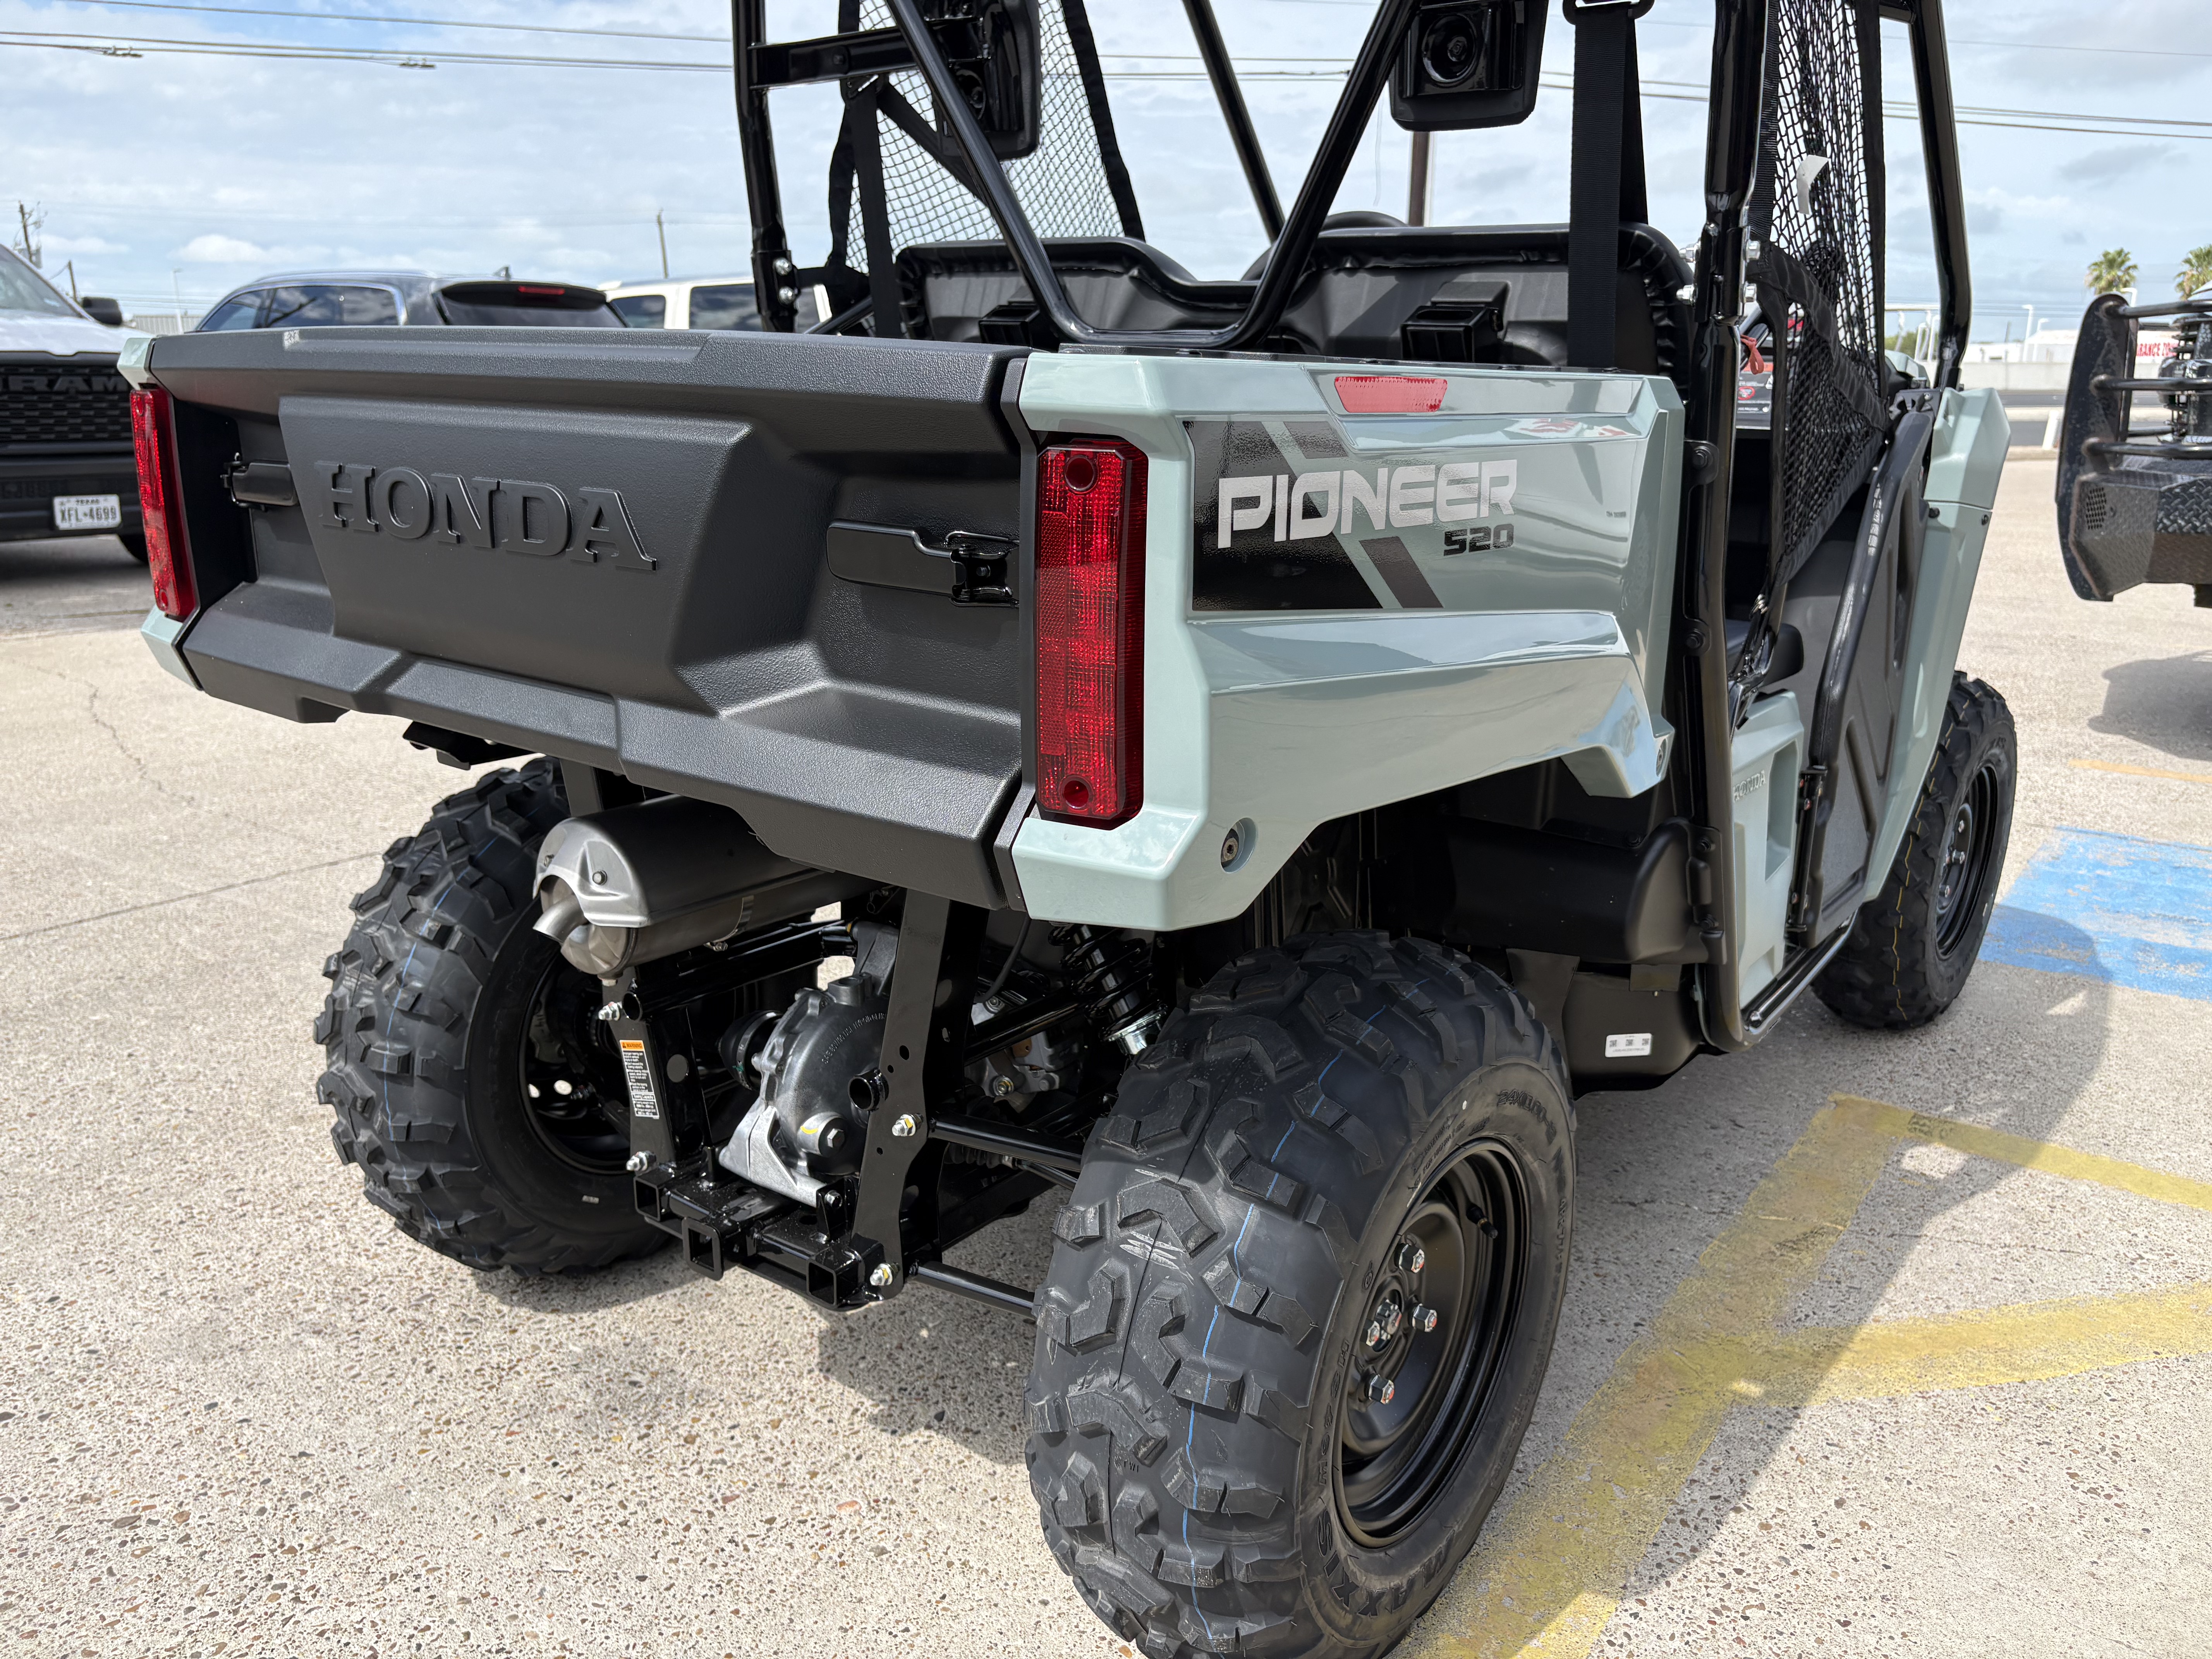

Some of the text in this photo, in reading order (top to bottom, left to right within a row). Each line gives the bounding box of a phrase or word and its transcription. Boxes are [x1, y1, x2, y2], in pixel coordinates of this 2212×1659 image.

[9, 375, 129, 392] RAM
[314, 461, 657, 570] HONDA
[1218, 459, 1517, 549] PIONEER
[1444, 524, 1514, 556] 520
[1733, 769, 1766, 803] HONDA
[1317, 1510, 1456, 1617] MAXXIS
